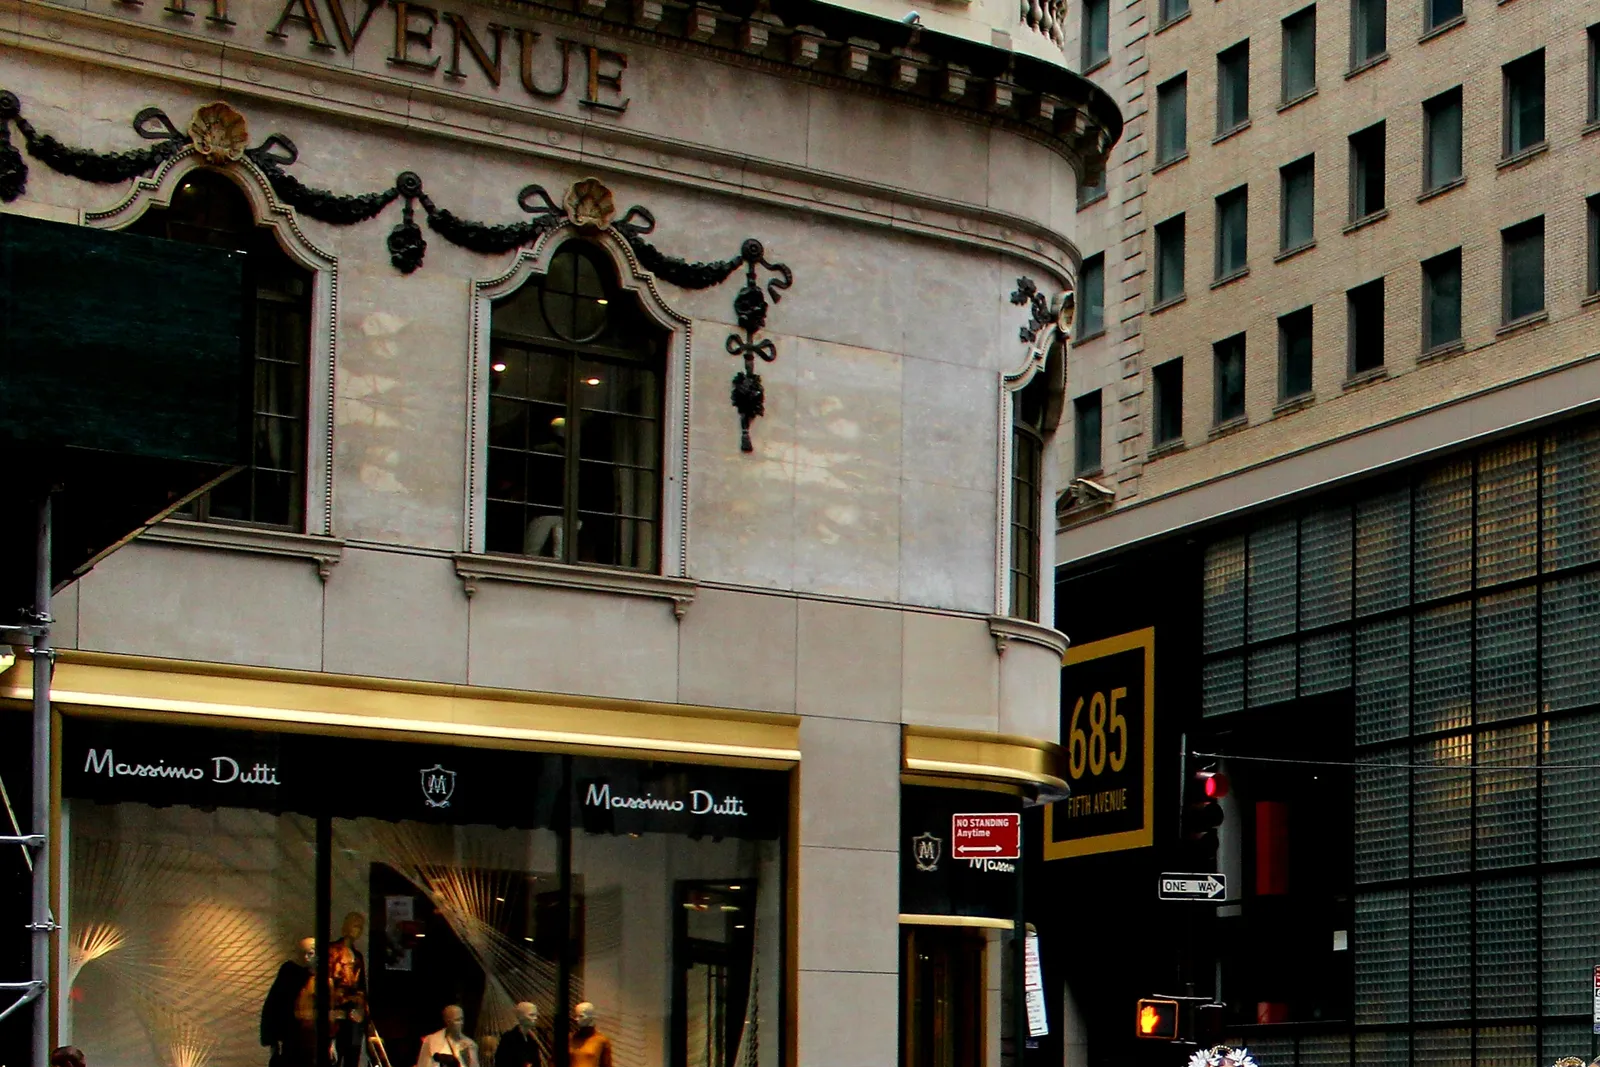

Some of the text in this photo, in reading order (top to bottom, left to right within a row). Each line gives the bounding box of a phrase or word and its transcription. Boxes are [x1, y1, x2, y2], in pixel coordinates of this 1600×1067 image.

[266, 0, 630, 113] AVENUE
[1069, 687, 1127, 779] 685
[84, 748, 281, 785] Massimo Dutti
[585, 783, 748, 816] Massimo Dutti
[1068, 788, 1127, 818] FIFTH AVENUE
[956, 818, 1009, 827] NO STANDING
[956, 829, 991, 839] Anytime
[1165, 881, 1218, 892] ONE WAY
